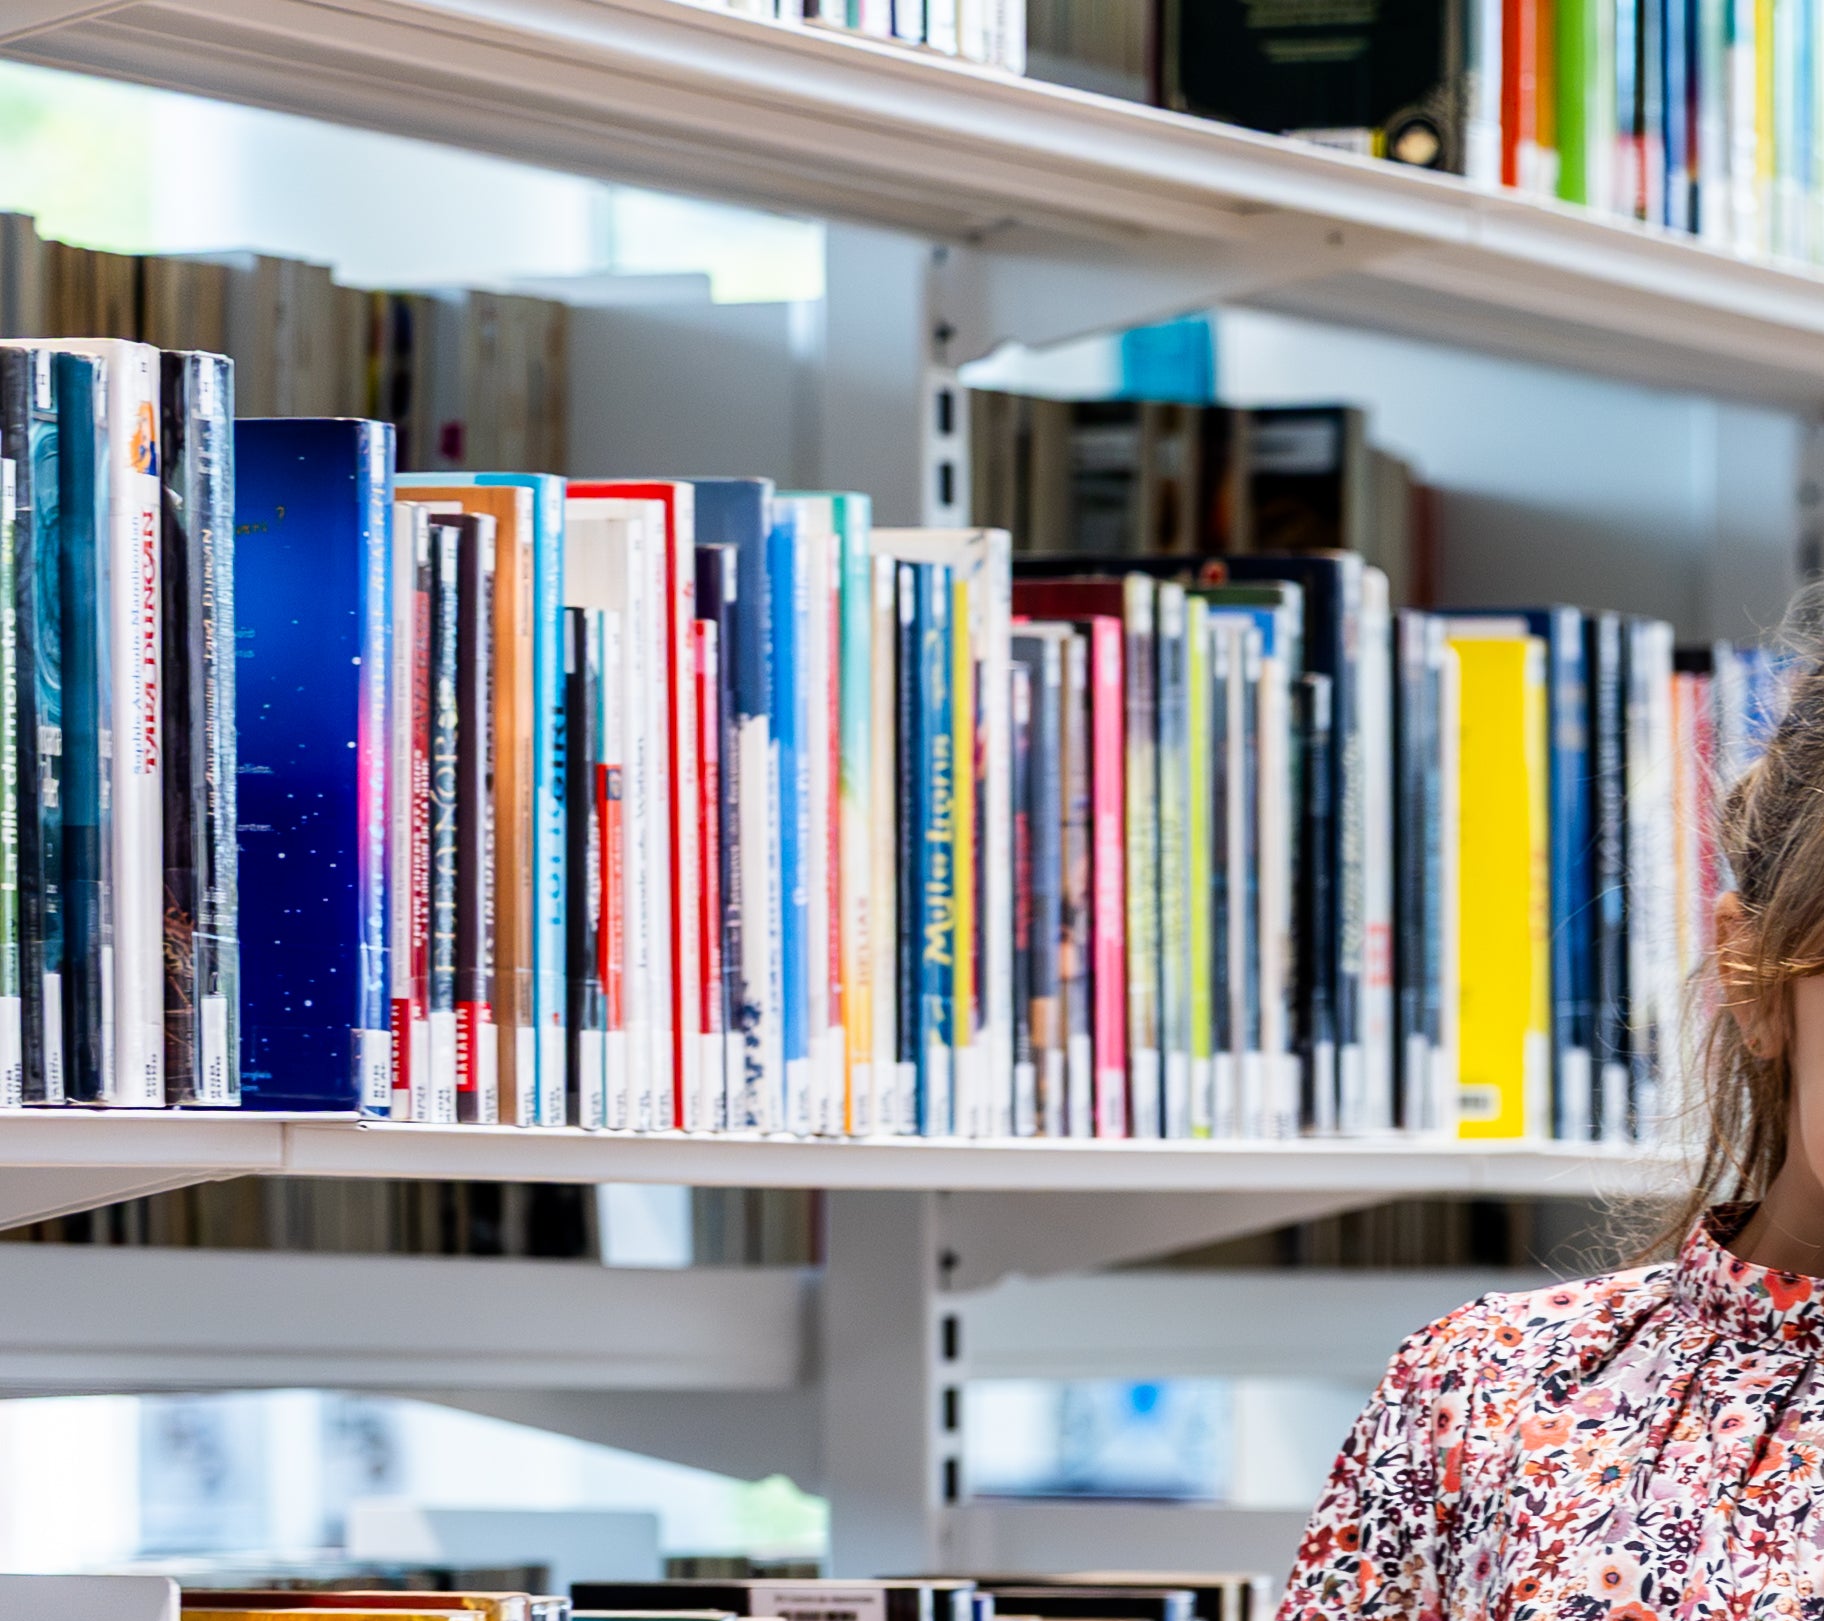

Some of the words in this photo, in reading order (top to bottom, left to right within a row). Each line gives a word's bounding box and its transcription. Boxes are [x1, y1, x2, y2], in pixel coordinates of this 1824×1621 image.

[142, 511, 158, 672] DUNCAN
[2, 604, 17, 737] monstre
[2, 742, 17, 784] du
[2, 791, 17, 844] fille
